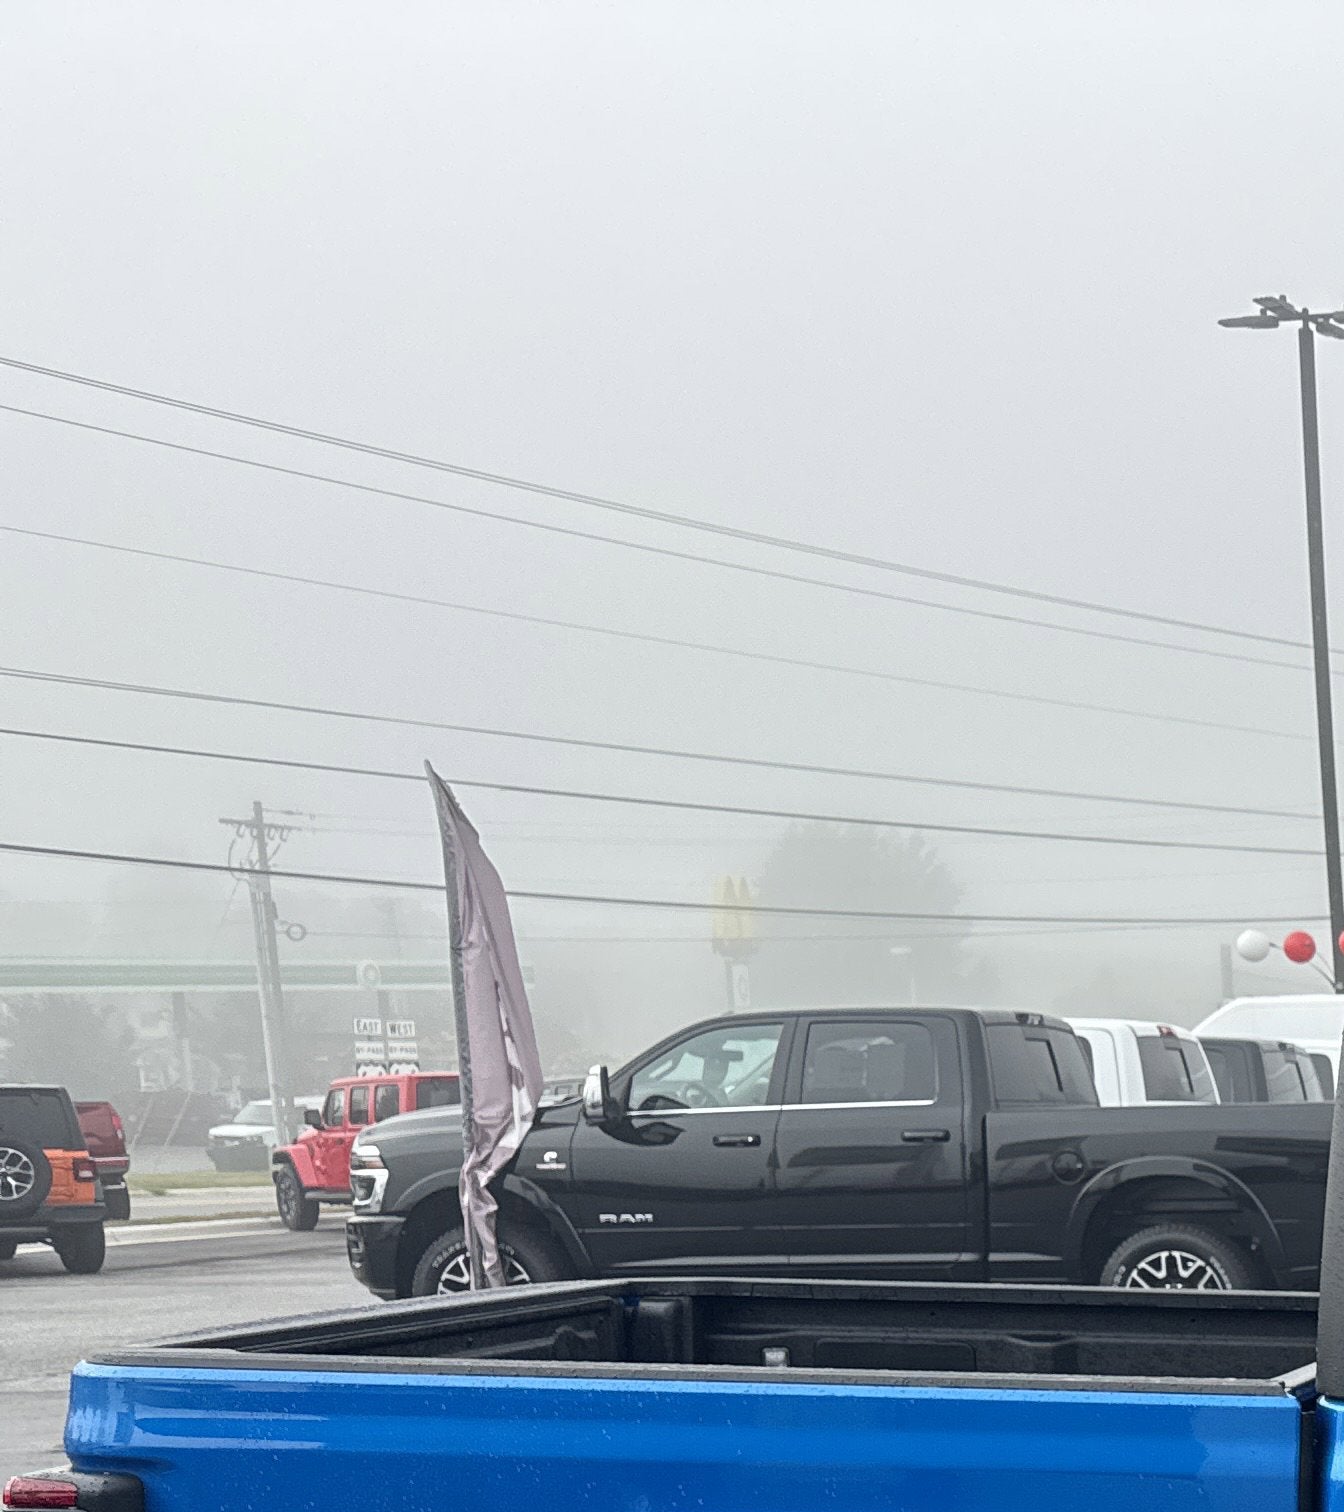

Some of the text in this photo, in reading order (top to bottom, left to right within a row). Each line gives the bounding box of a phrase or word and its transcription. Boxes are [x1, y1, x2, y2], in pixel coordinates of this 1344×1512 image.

[356, 1020, 380, 1034] EAST
[388, 1022, 414, 1036] WEST
[598, 1213, 655, 1224] RAM
